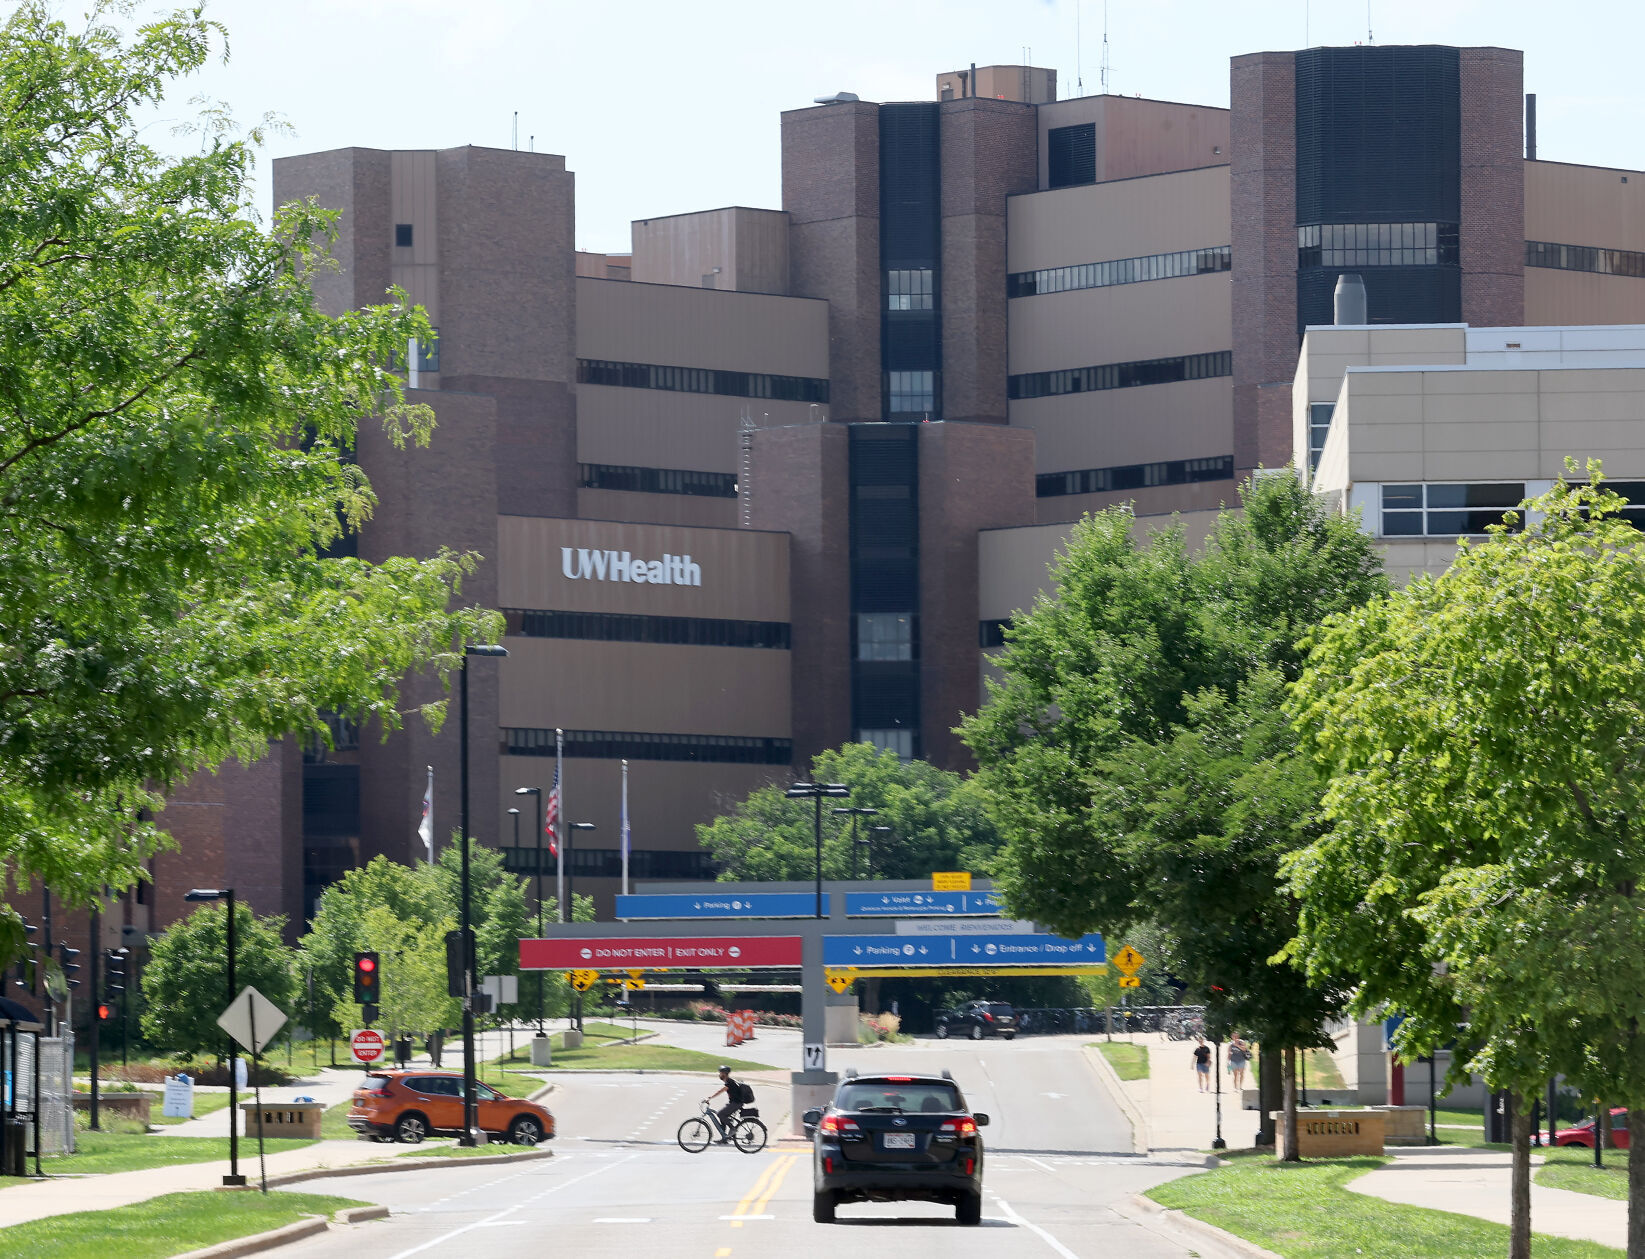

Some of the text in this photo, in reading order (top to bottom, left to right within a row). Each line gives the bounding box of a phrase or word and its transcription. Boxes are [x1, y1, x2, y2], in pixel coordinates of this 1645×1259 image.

[703, 900, 731, 911] Parking
[595, 947, 665, 958] DO NOT ENTER
[675, 947, 724, 957] EXIT ONLY
[866, 945, 901, 957] Parking
[998, 943, 1039, 953] Entrance
[1044, 943, 1068, 954] Drop
[1068, 942, 1083, 952] off
